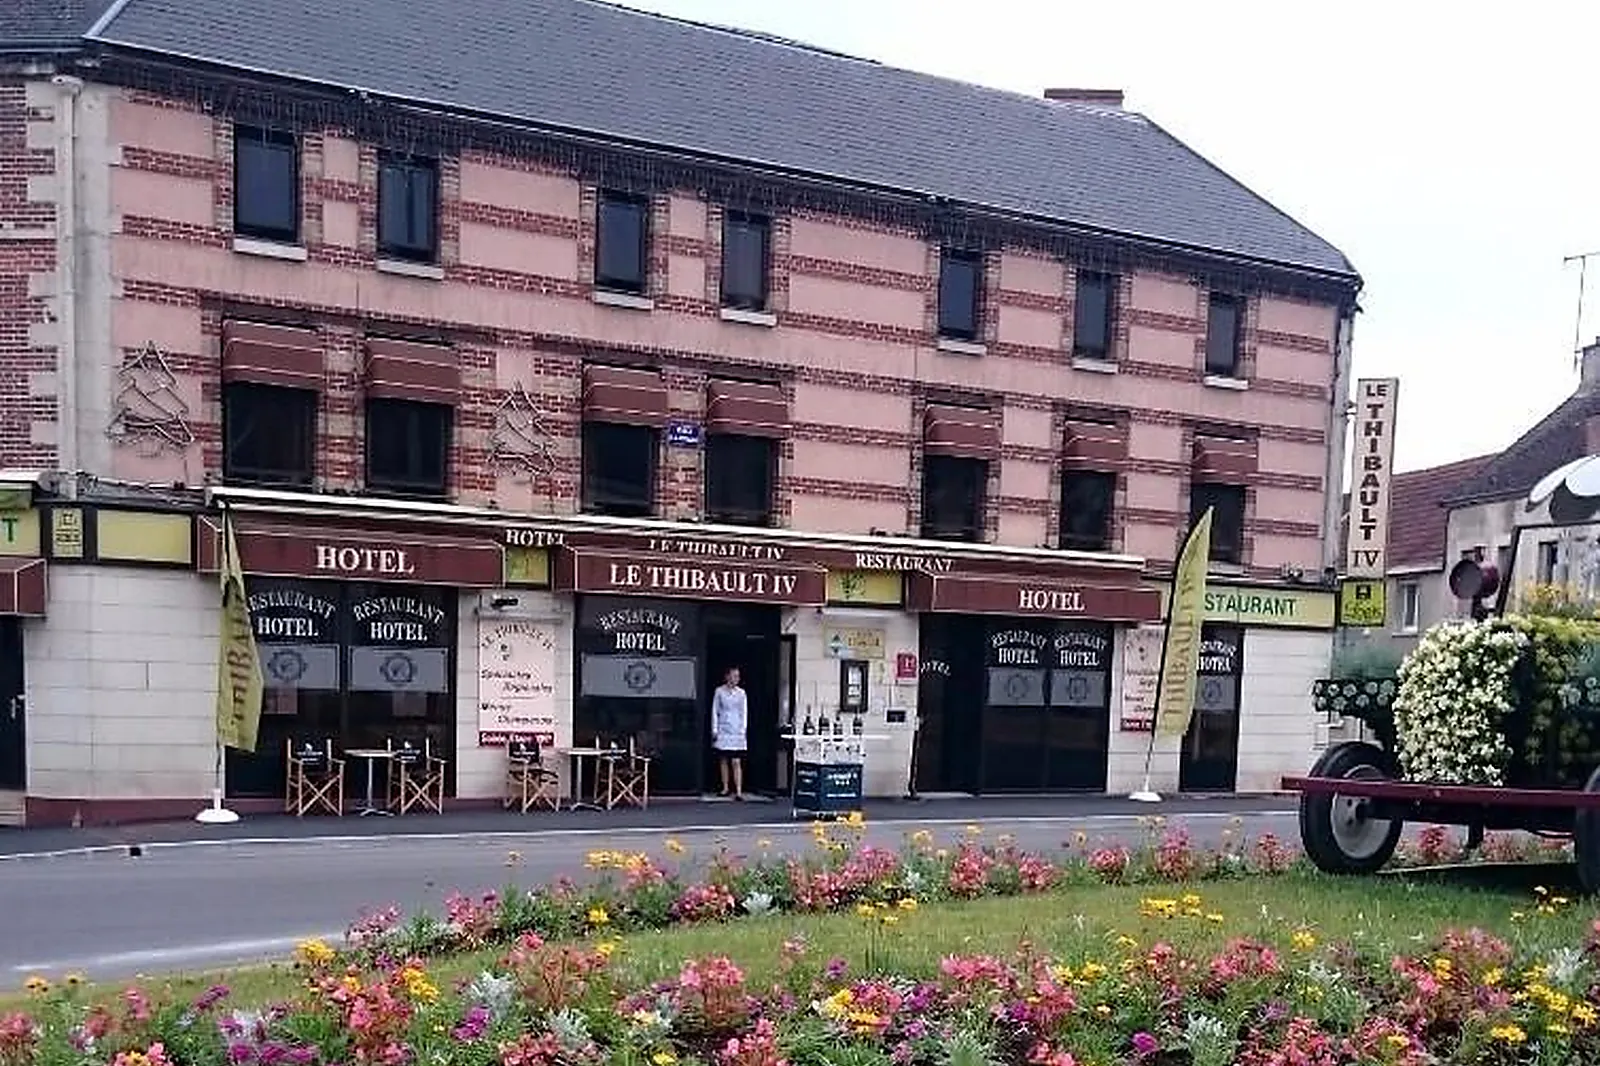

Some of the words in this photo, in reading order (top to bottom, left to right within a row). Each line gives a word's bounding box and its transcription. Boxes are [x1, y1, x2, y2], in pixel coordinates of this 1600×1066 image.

[1366, 384, 1388, 398] LE
[1360, 403, 1384, 541] THIBAULT
[505, 528, 565, 546] HOTEL
[649, 538, 671, 552] LE
[676, 541, 763, 560] THIBAULT
[1353, 550, 1380, 568] IV
[315, 545, 416, 575] HOTEL
[855, 552, 953, 572] RESTAURANT
[610, 563, 642, 587] LE
[646, 566, 772, 595] THIBAULT
[774, 575, 798, 596] IV
[353, 596, 445, 624] RESTAURANT
[1018, 589, 1085, 611] HOTEL
[1204, 593, 1296, 616] STAURANT
[257, 617, 319, 637] HOTEL
[370, 621, 428, 641] HOTEL
[615, 631, 667, 651] HOTEL
[998, 648, 1039, 664] HOTEL
[1060, 649, 1101, 666] HOTEL
